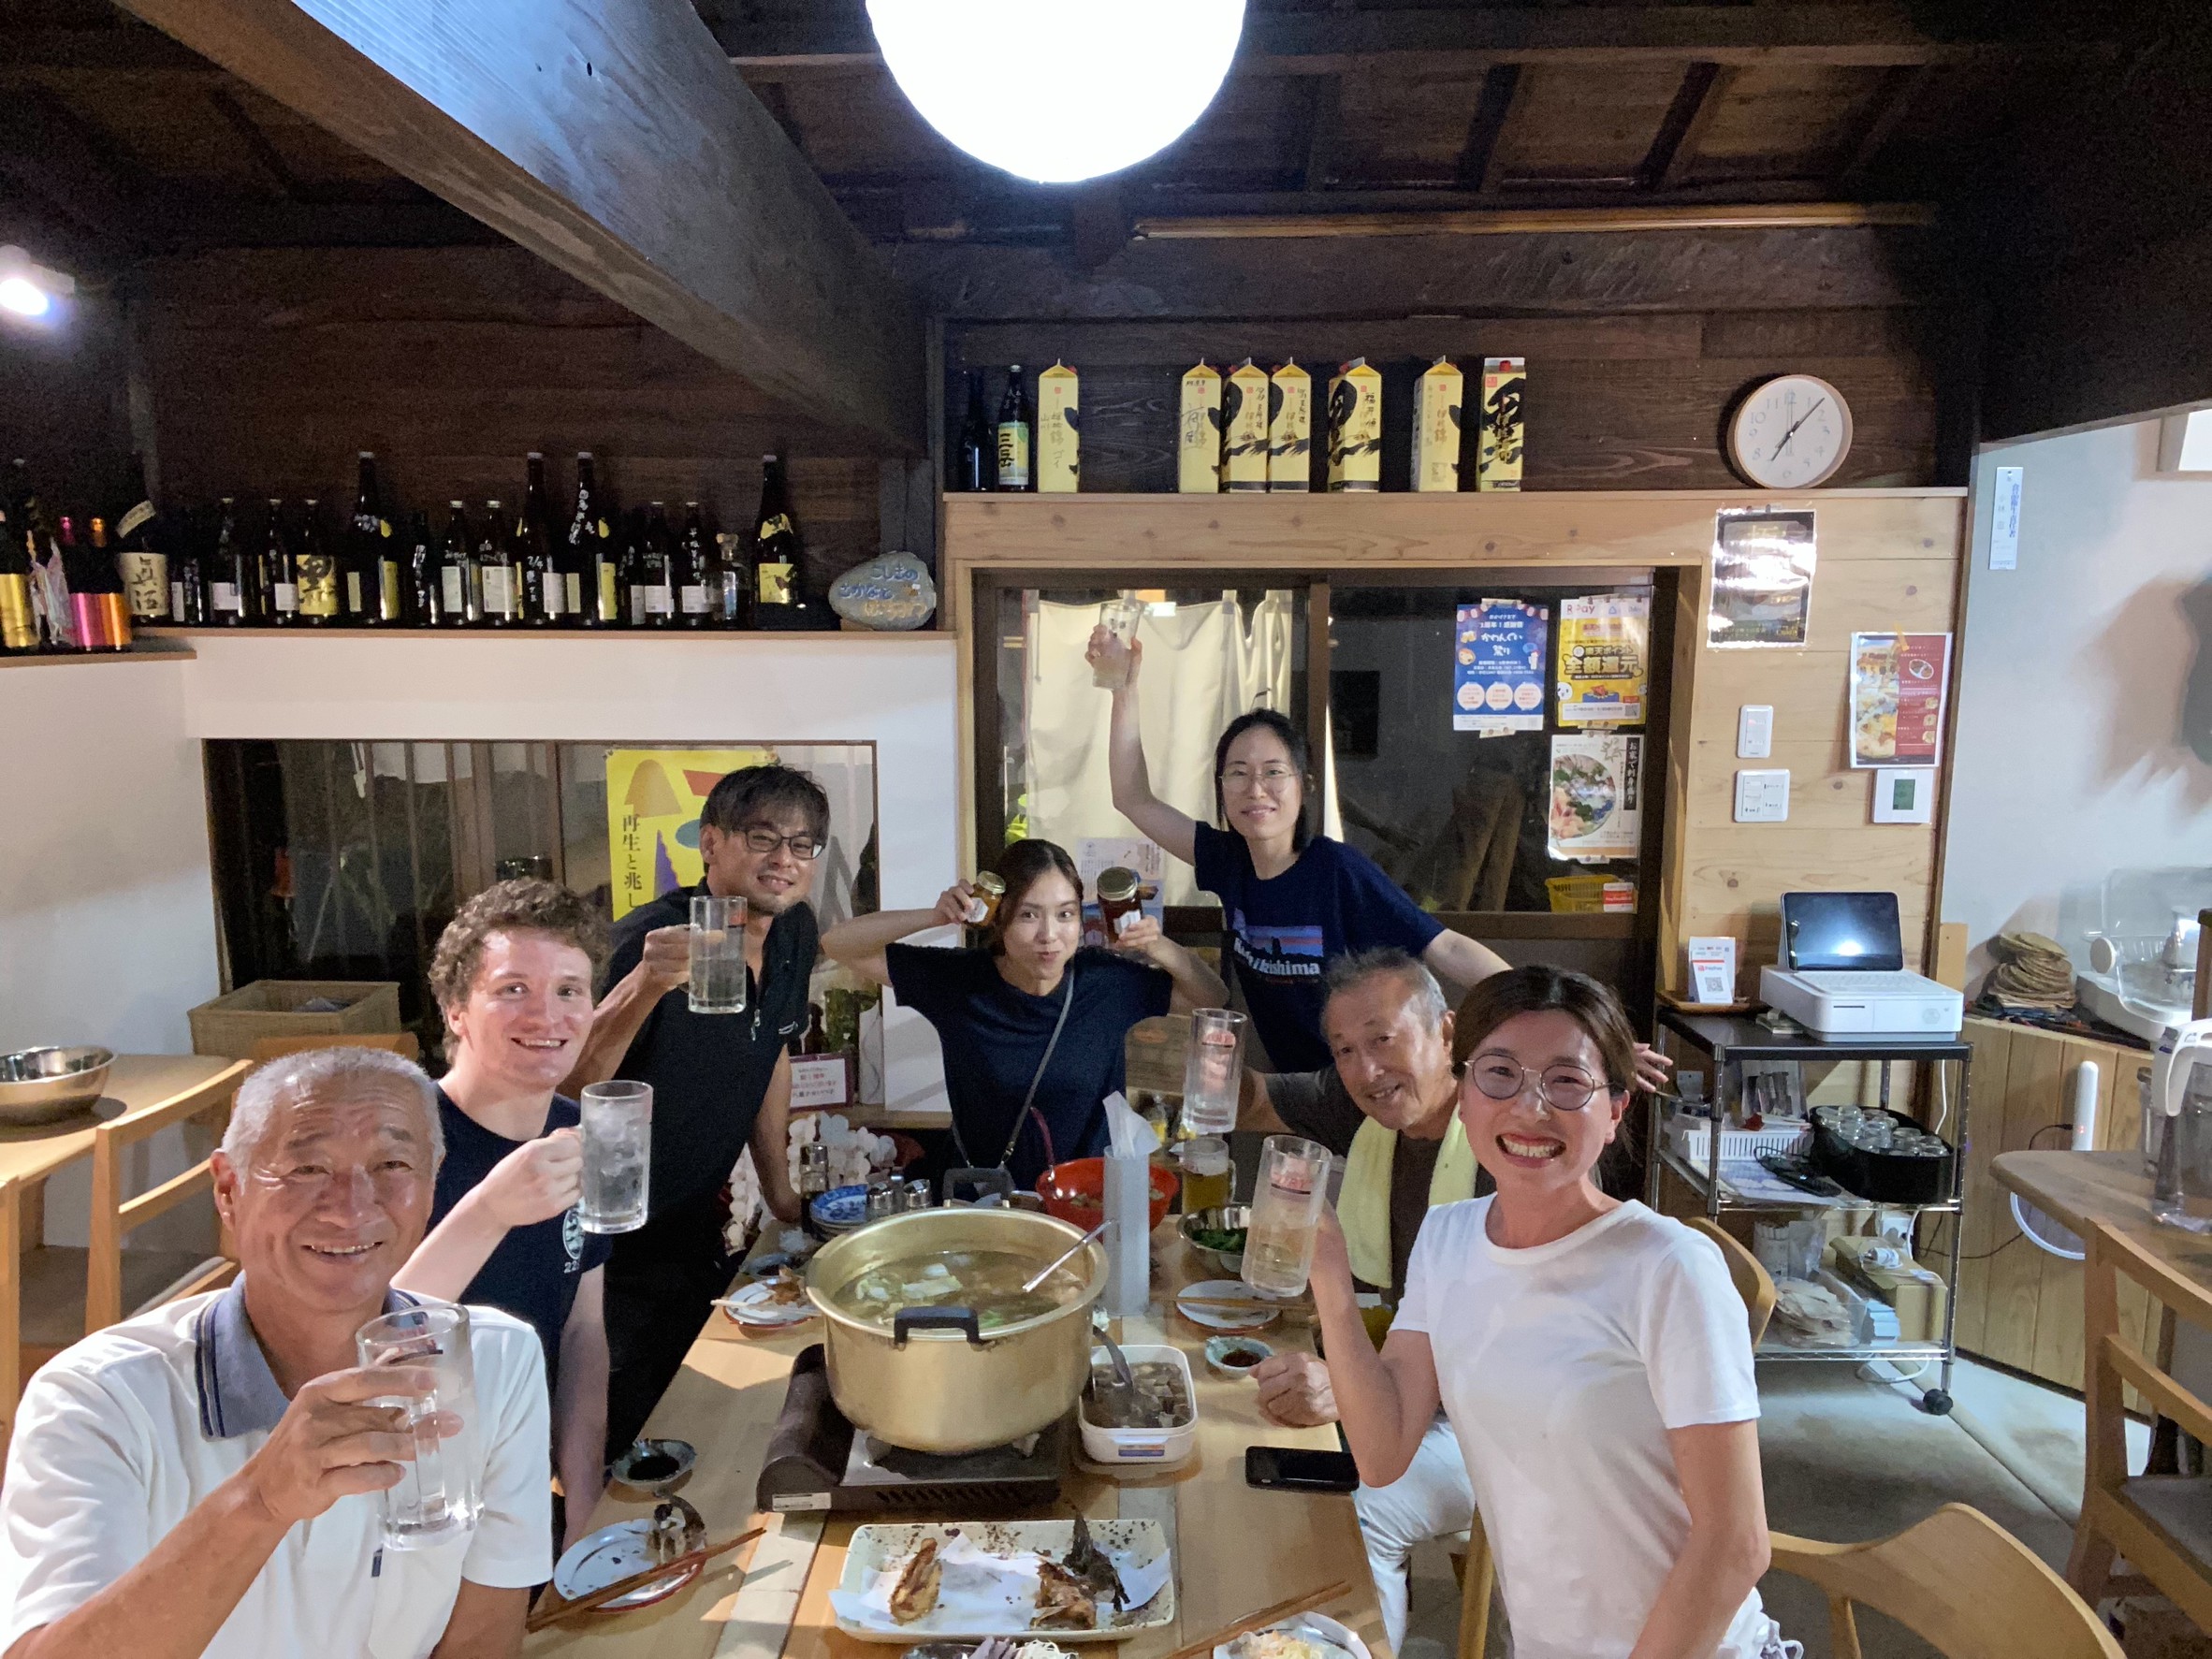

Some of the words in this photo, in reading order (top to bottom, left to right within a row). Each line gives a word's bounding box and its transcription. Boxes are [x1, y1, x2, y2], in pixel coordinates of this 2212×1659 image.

[1784, 389, 1797, 404] 12
[1807, 396, 1812, 408] 1
[1767, 399, 1778, 409] 11
[1751, 412, 1766, 424] 10
[1817, 409, 1826, 421] 2
[1565, 656, 1638, 674] 全額還元
[622, 814, 642, 909] 再生と兆し
